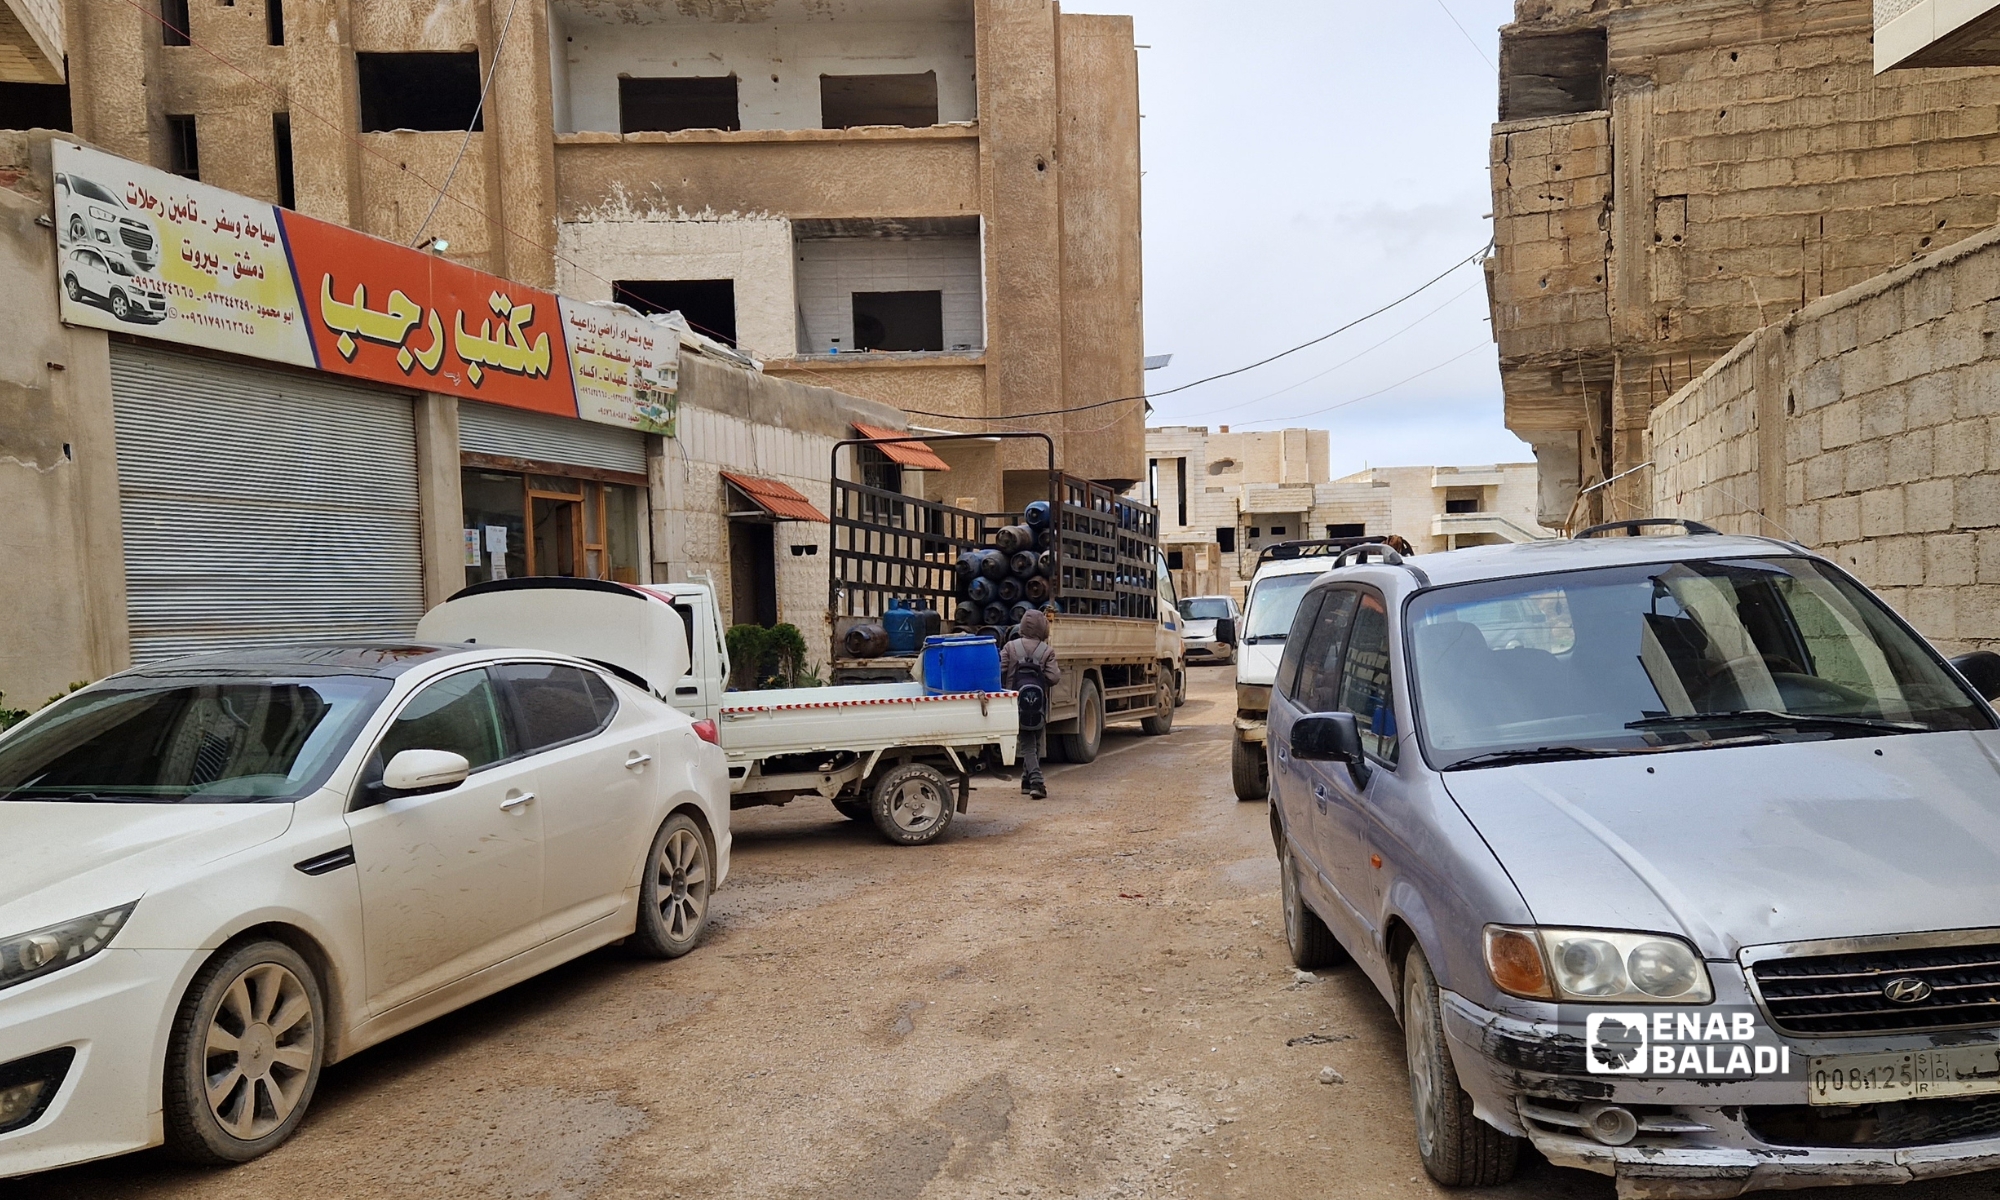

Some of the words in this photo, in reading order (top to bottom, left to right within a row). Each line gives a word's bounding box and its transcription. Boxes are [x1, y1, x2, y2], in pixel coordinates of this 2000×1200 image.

[126, 181, 165, 217] رحلات
[168, 193, 198, 222] تأمين
[212, 209, 241, 239] وسفر
[244, 213, 276, 246] سياحة
[181, 239, 219, 275] بيروت
[232, 250, 265, 280] دمشق
[256, 304, 281, 319] محمود
[320, 272, 444, 371] رجب
[570, 310, 596, 334] زراعية
[454, 290, 551, 385] مكتب
[620, 328, 642, 347] وشراء
[642, 338, 654, 351] بيع
